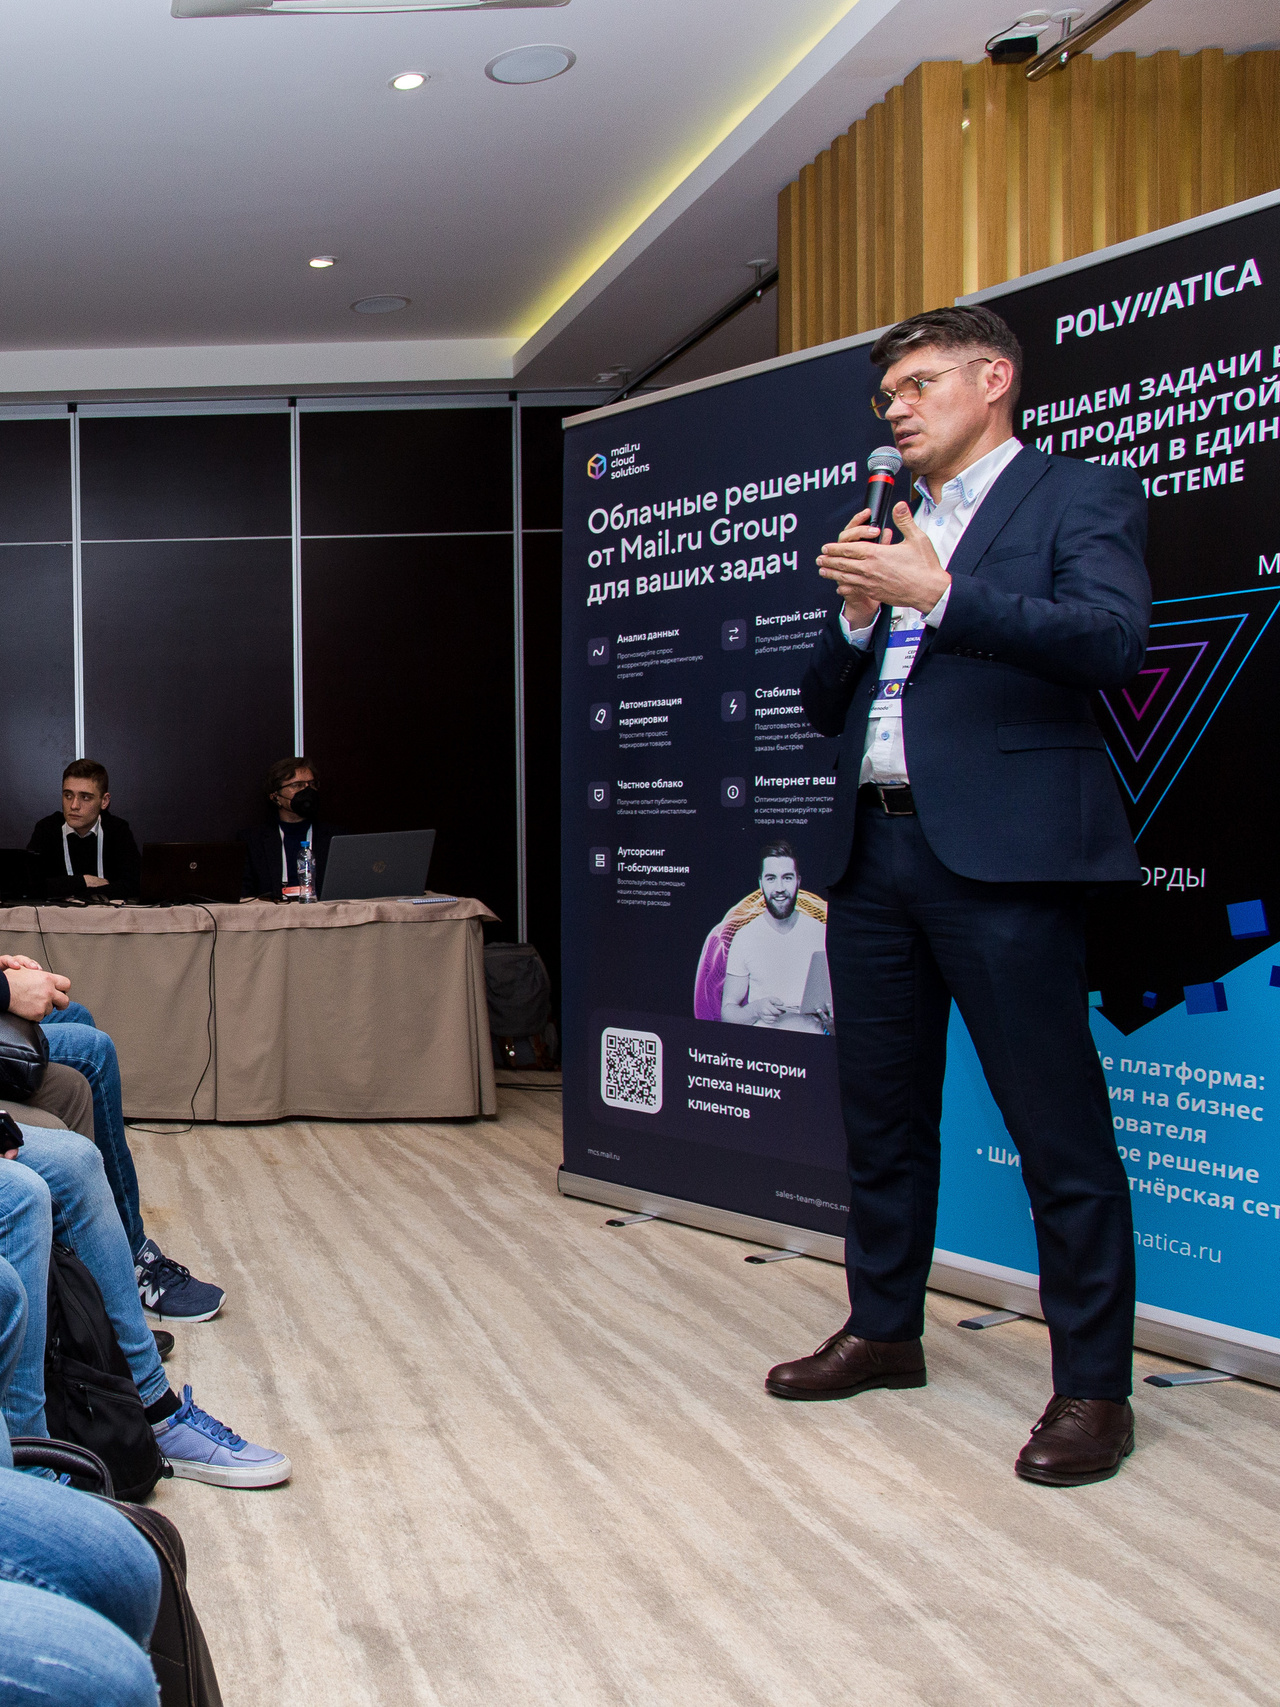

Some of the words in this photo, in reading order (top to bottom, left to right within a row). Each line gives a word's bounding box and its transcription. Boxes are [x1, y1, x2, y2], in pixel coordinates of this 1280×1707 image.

[1022, 383, 1132, 430] РЕШАЕМ
[1139, 349, 1262, 401] ЗАДАЧИ
[1061, 374, 1280, 452] ПРОДВИНУТОЙ
[610, 442, 640, 458] mail.ru
[1168, 437, 1187, 461] В
[610, 453, 635, 469] cloud
[610, 463, 650, 480] solutions
[587, 491, 718, 534] Облачные
[725, 461, 858, 514] решения
[587, 547, 615, 569] от
[620, 529, 703, 563] Mail.ru
[709, 513, 798, 546] Group
[586, 579, 630, 606] для
[636, 564, 715, 596] ваших
[720, 551, 798, 582] задач
[755, 610, 801, 626] Быстрый
[802, 608, 828, 621] сайт
[616, 633, 647, 644] Анализ
[647, 628, 680, 641] данных
[755, 633, 789, 643] Получайте
[618, 697, 683, 710] Автоматизация
[618, 715, 669, 727] маркировки
[617, 779, 650, 790] Частное
[651, 778, 684, 789] облако
[754, 775, 811, 789] Интернет
[616, 846, 666, 859] Аутсорсинг
[616, 862, 690, 875] IT-обслуживания
[688, 1047, 744, 1069] Читайте
[746, 1060, 807, 1079] истории
[1120, 1061, 1265, 1091] платформа:
[687, 1074, 733, 1093] успеха
[736, 1082, 781, 1100] наших
[687, 1098, 751, 1120] клиентов
[1142, 1090, 1169, 1107] на
[1176, 1091, 1264, 1122] бизнес
[1112, 1115, 1207, 1144] ователя
[587, 1147, 620, 1161] mcs.mail.ru
[1147, 1150, 1260, 1184] решение
